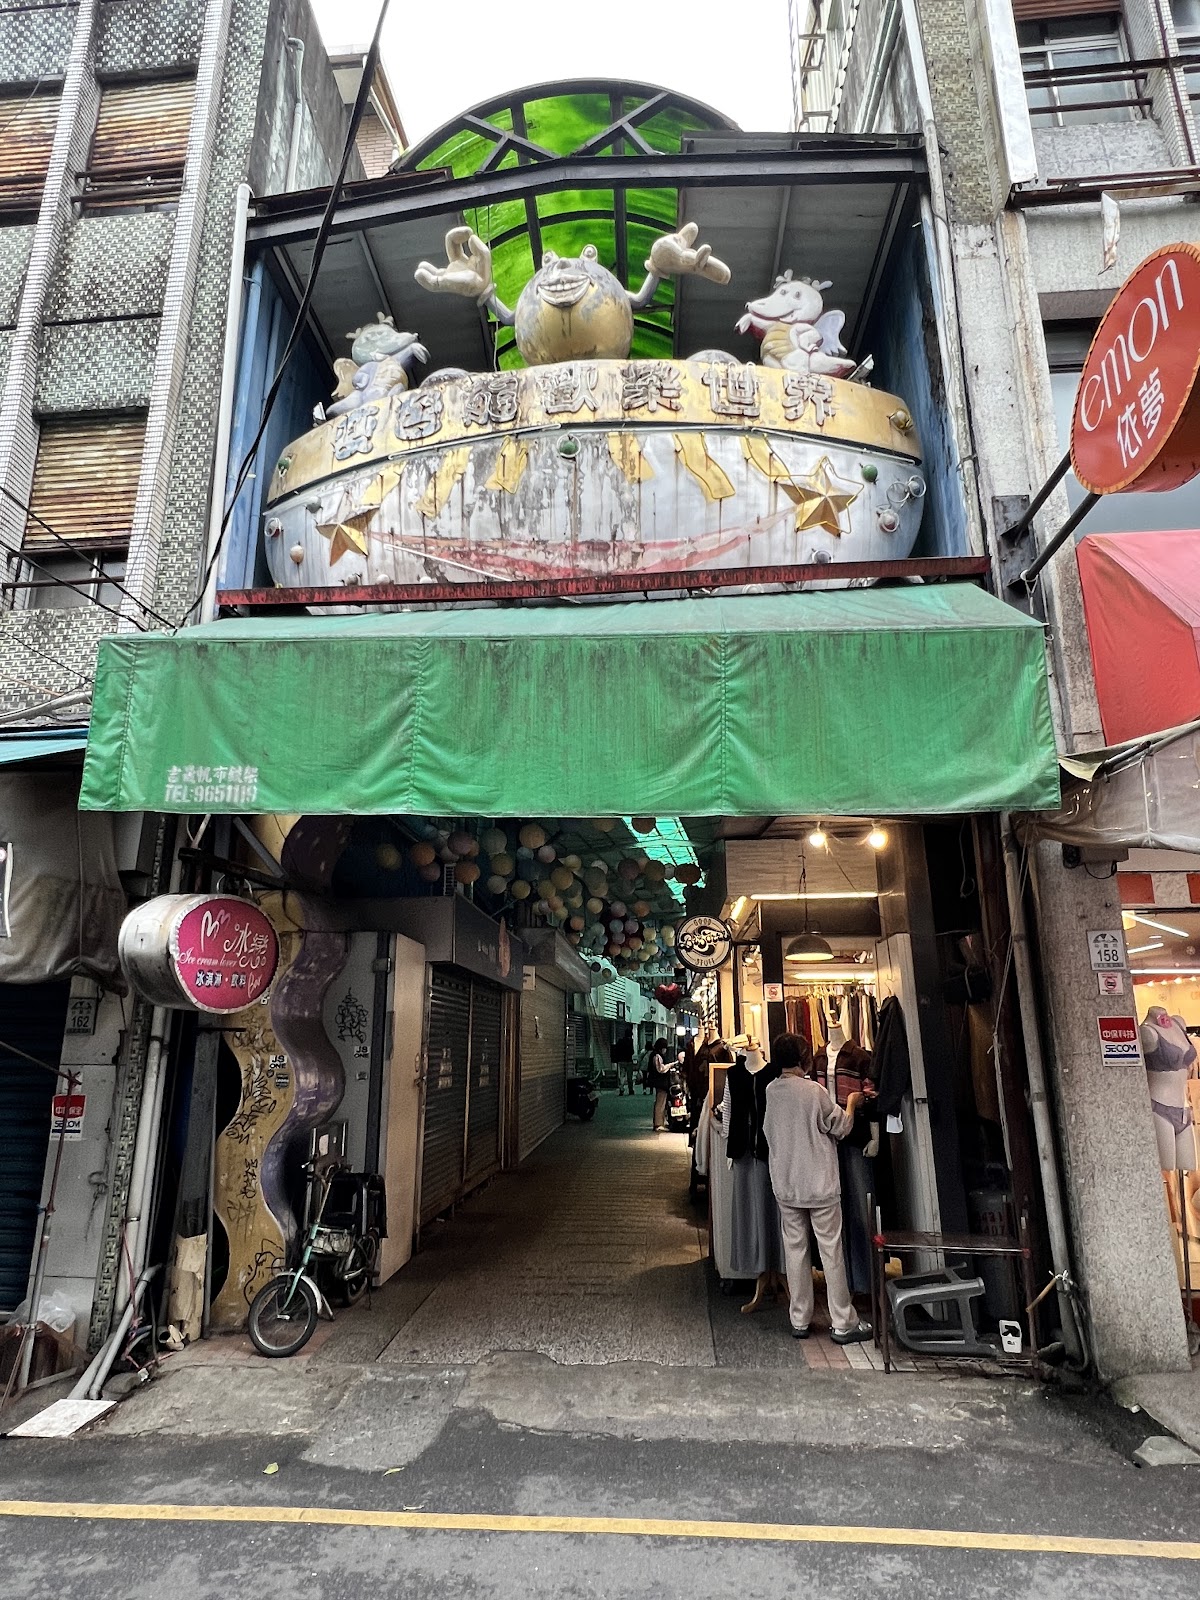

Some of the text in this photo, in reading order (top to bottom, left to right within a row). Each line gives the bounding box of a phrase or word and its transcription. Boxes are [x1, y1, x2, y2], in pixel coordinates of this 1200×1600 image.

[1081, 259, 1184, 432] emon
[1116, 367, 1165, 468] 依夢
[693, 918, 712, 927] GOOD
[180, 947, 197, 965] Ice
[197, 956, 219, 967] cream
[1097, 949, 1119, 962] 158
[71, 1015, 90, 1029] 162
[1102, 1029, 1135, 1039] 中保科技
[1105, 1044, 1137, 1053] SECOM
[54, 1120, 81, 1128] SEOM
